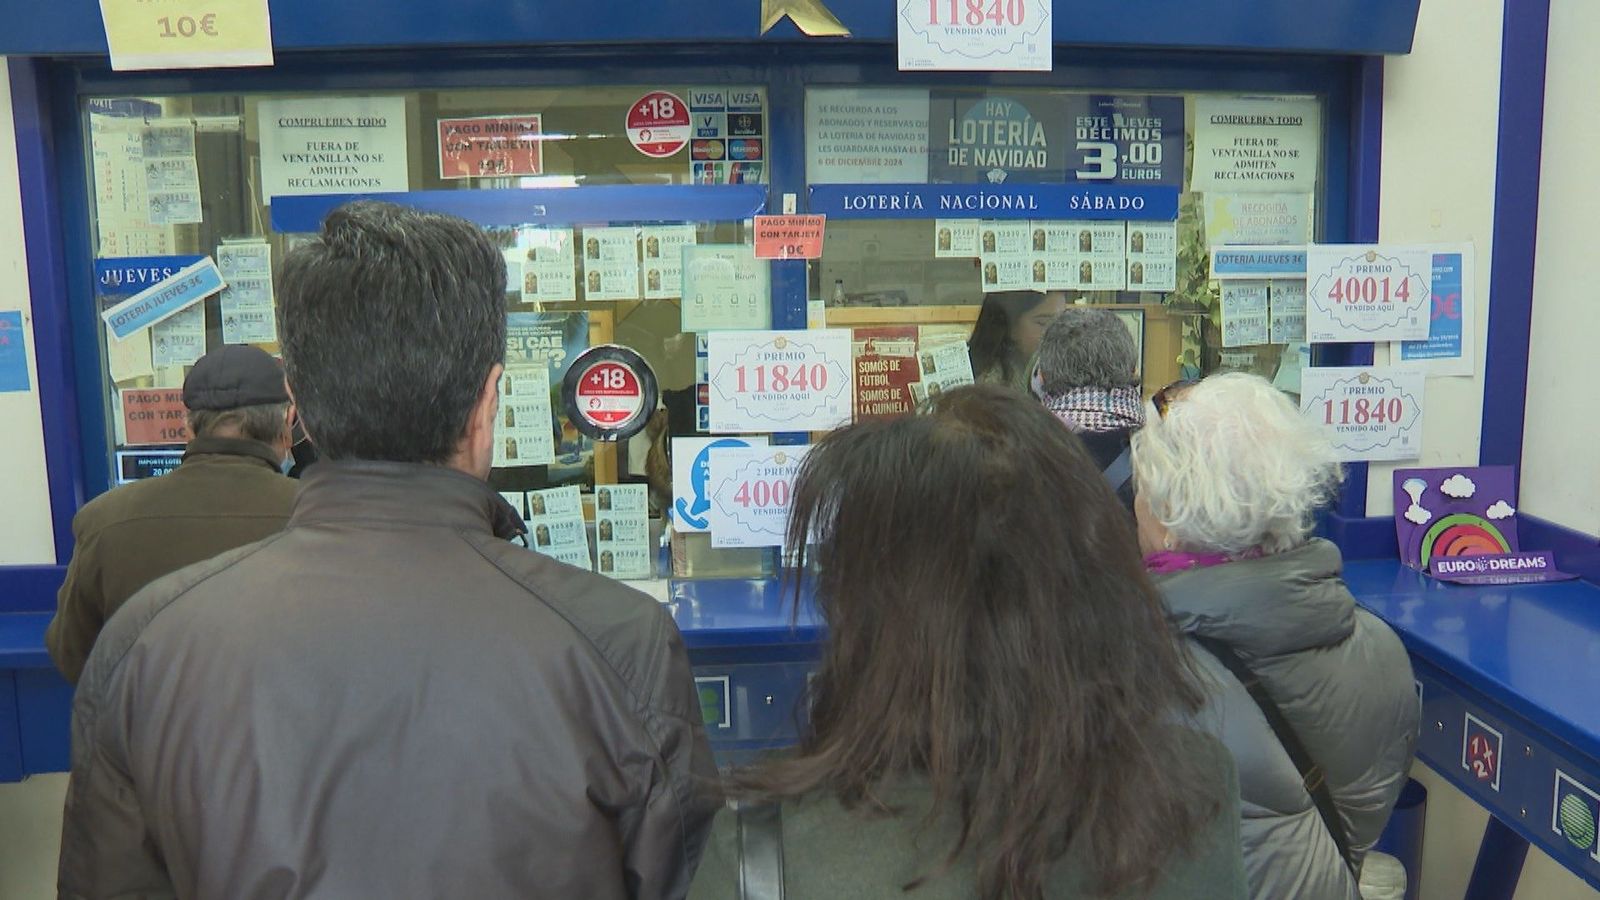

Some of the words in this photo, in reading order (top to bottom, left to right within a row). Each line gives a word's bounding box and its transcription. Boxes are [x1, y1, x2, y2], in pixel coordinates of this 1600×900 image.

[926, 0, 1025, 26] 11840
[944, 27, 983, 35] VENDIDO
[695, 93, 723, 104] VISA
[732, 93, 760, 104] VISA
[640, 98, 675, 119] +18
[818, 105, 828, 113] SE
[830, 105, 873, 114] RECUERDA
[874, 106, 881, 114] A
[882, 106, 898, 115] LOS
[985, 102, 1012, 117] HAY
[278, 117, 353, 127] COMPRUEBEN
[358, 117, 387, 127] TODO
[818, 119, 866, 128] ABONADOS
[874, 120, 914, 129] RESERVAS
[1076, 116, 1108, 128] ESTE
[1210, 114, 1275, 125] COMPRUEBEN
[1278, 116, 1303, 126] TODO
[818, 132, 829, 140] LA
[878, 133, 916, 141] NAVIDAD
[949, 115, 1047, 148] LOTERÍA
[306, 142, 342, 151] FUERA
[345, 142, 360, 151] DE
[1233, 138, 1264, 147] FUERA
[1266, 138, 1279, 146] DE
[818, 145, 832, 153] LES
[881, 146, 907, 154] HASTA
[909, 146, 918, 154] EL
[1211, 149, 1271, 158] VENTANILLA
[1273, 150, 1286, 158] NO
[1288, 150, 1300, 158] SE
[354, 153, 369, 163] NO
[372, 154, 384, 163] SE
[948, 148, 968, 166] DE
[974, 148, 1047, 168] NAVIDAD
[1233, 160, 1277, 169] ADMITEN
[309, 166, 359, 175] ADMITEN
[1121, 168, 1162, 180] EUROS
[1214, 171, 1295, 180] RECLAMACIONES
[288, 178, 382, 188] RECLAMACIONES
[843, 192, 924, 210] LOTERÍA
[1070, 191, 1146, 210] SÁBADO
[1217, 255, 1255, 265] LOTERIA
[1257, 255, 1290, 265] JUEVES
[1356, 265, 1393, 273] PREMIO
[101, 267, 172, 286] JUEVES
[1328, 276, 1410, 304] 40014
[110, 302, 153, 329] LOTERIA
[154, 285, 188, 308] JUEVES
[1344, 304, 1376, 312] VENDIDO
[526, 336, 563, 348] CAE
[764, 352, 806, 361] PREMIO
[859, 361, 889, 373] SOMOS
[890, 360, 901, 371] DE
[591, 368, 625, 389] +18
[736, 363, 828, 393] 11840
[860, 389, 889, 401] SOMOS
[891, 388, 902, 400] DE
[1349, 386, 1385, 395] PREMIO
[128, 394, 160, 404] PAGO
[860, 404, 871, 415] LA
[872, 402, 909, 415] QUINIELA
[1323, 397, 1403, 425] 11840
[128, 411, 154, 421] CON
[160, 410, 183, 420] TAR
[161, 428, 186, 439] 10€
[1336, 425, 1368, 433] VENDIDO
[1437, 560, 1475, 573] EURO
[1489, 557, 1547, 570] DREAMS
